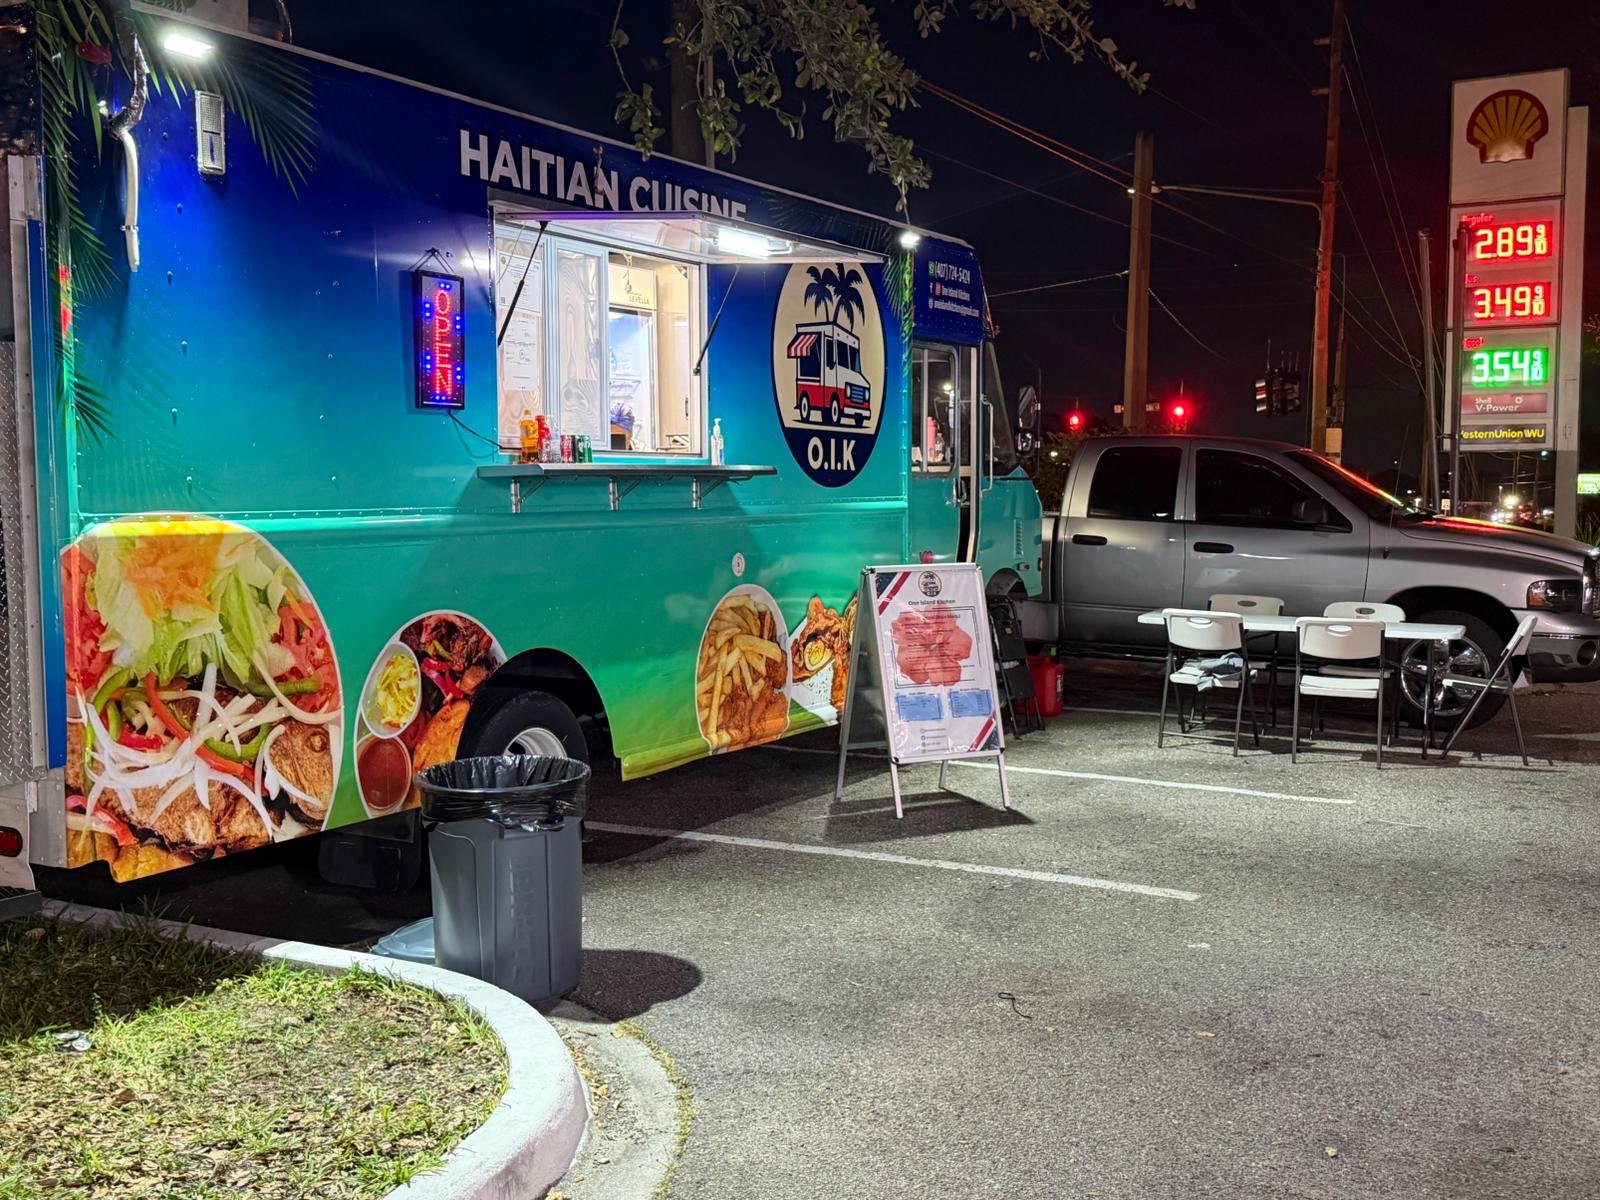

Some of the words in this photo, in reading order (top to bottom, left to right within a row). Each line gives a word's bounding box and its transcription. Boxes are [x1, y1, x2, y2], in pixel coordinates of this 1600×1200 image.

[460, 129, 619, 211] HAITIAN
[629, 176, 747, 222] CUISINE
[1475, 225, 1533, 259] 2.89
[1474, 286, 1532, 318] 3.49
[435, 289, 452, 395] OPEN
[1472, 350, 1530, 383] 3.54
[1475, 404, 1520, 412] V-Power
[1461, 429, 1524, 439] esternUnion
[808, 436, 856, 471] O.I.K
